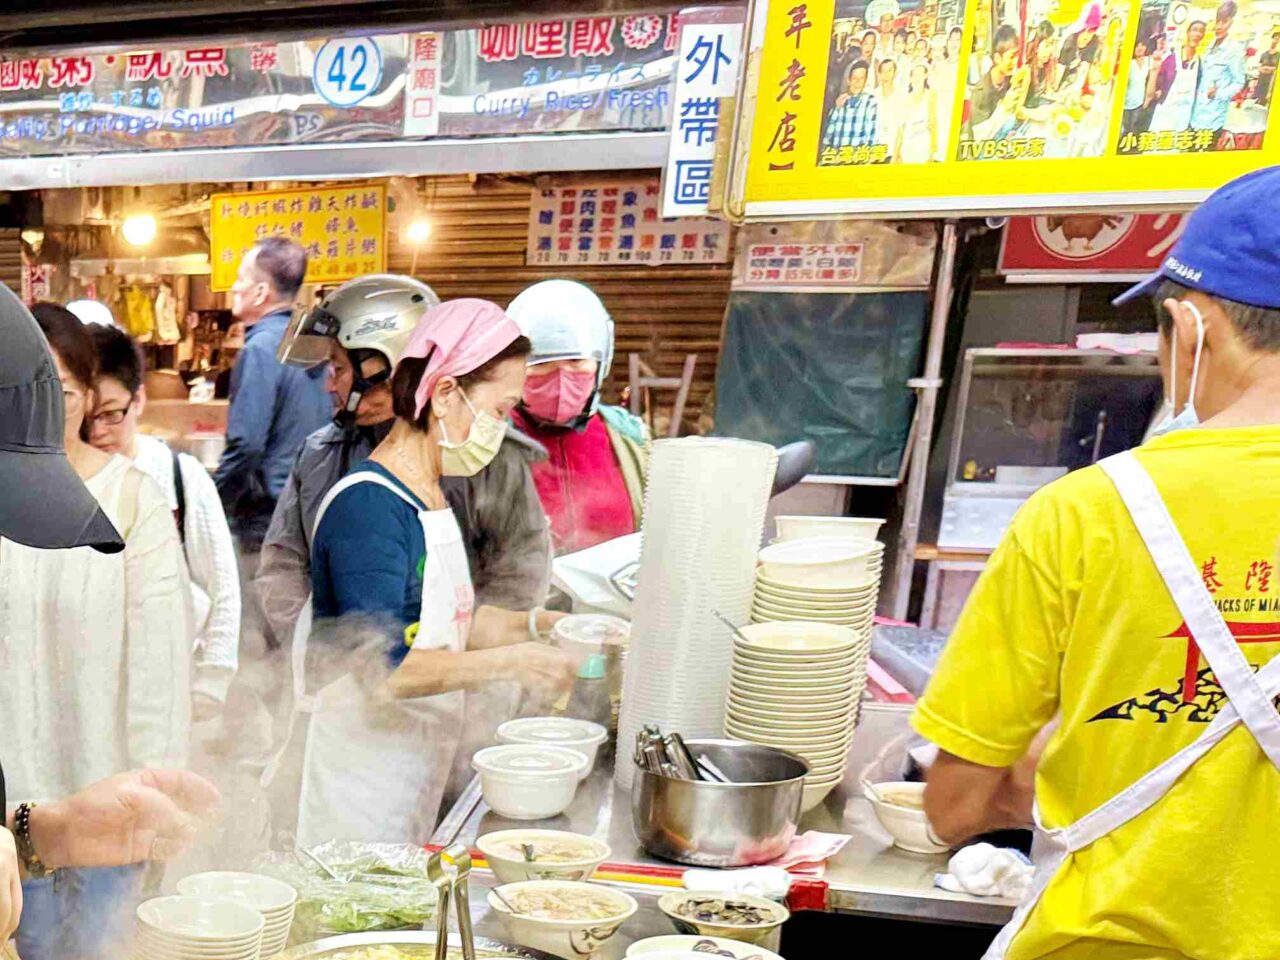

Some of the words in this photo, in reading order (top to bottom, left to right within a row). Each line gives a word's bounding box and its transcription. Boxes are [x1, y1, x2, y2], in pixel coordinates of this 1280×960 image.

[327, 44, 368, 92] 42
[473, 93, 530, 118] Curry
[673, 33, 733, 205] 外帶區
[1243, 598, 1256, 612] OF
